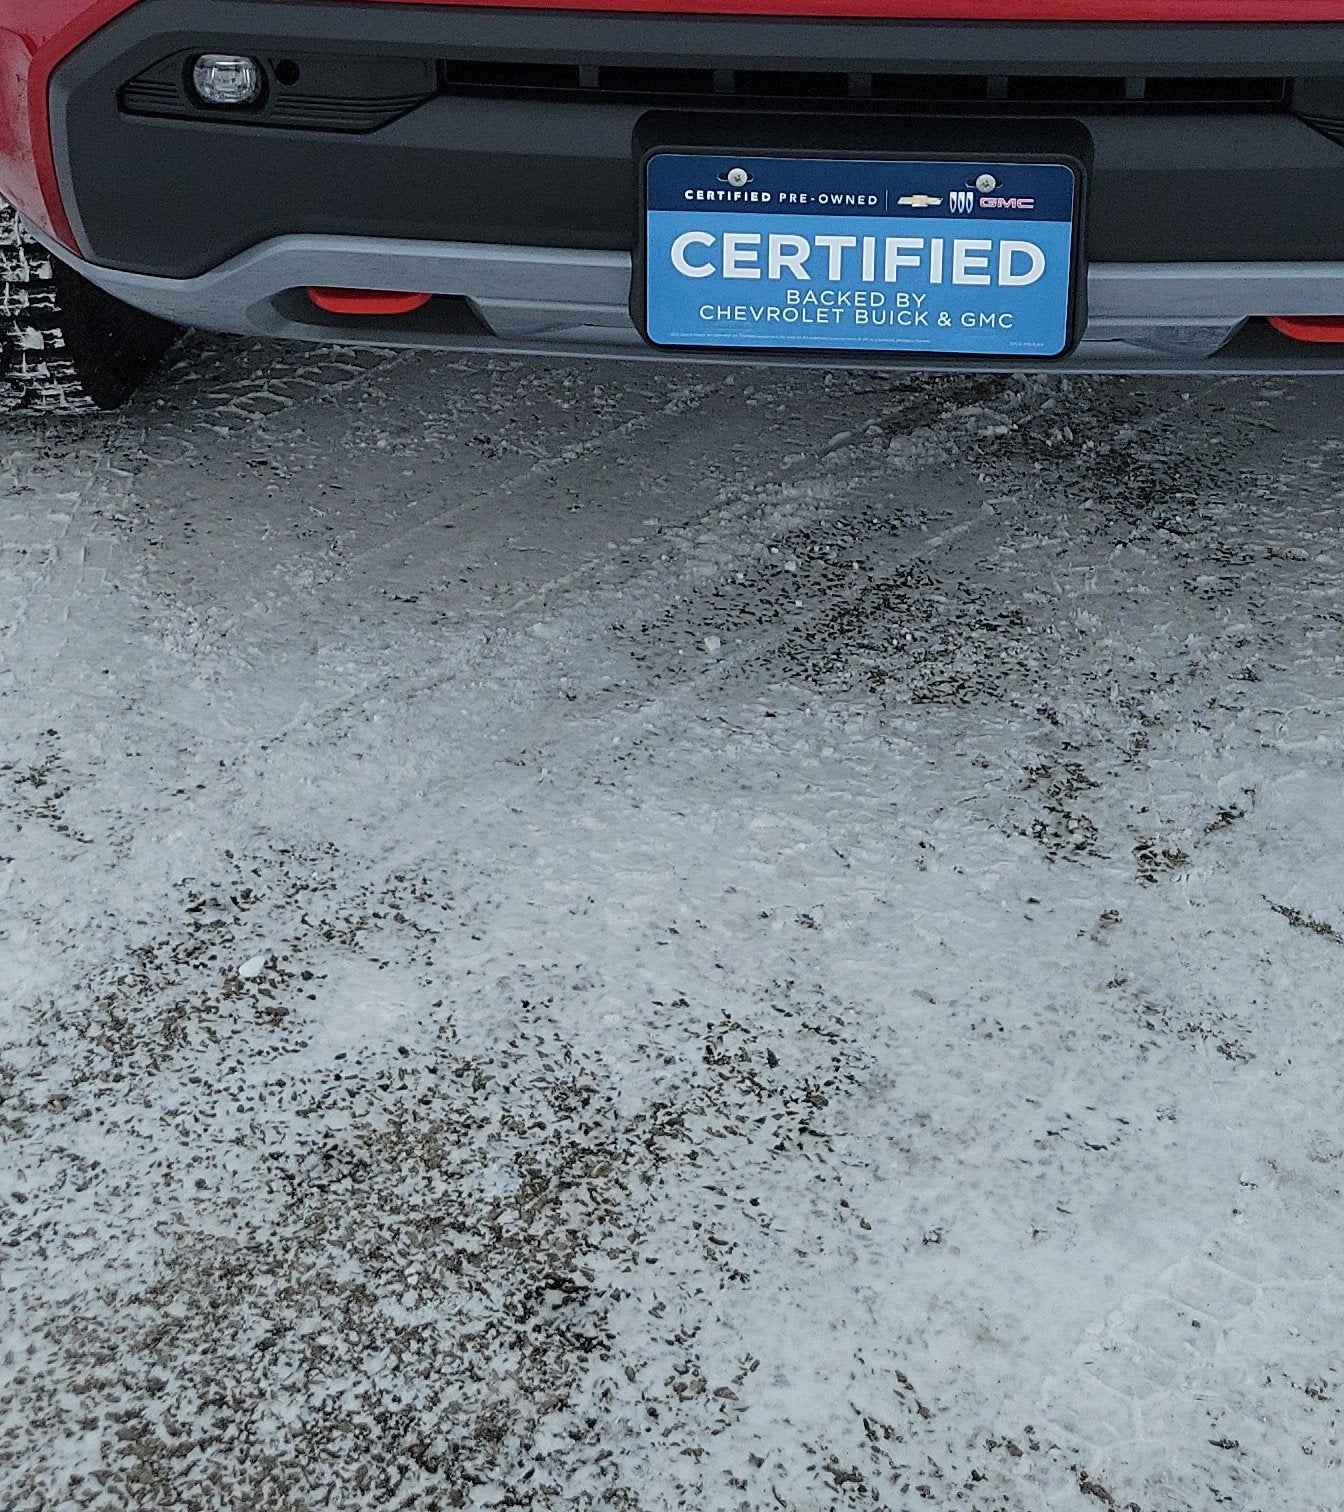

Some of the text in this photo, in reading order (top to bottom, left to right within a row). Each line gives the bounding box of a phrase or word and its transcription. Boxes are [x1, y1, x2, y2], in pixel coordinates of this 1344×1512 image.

[684, 189, 1034, 209] CERTIFIED PRE-OWNED GMC
[669, 230, 1047, 286] CERTIFIED
[786, 289, 927, 308] BACKED BY
[699, 305, 1014, 328] CHEVROLET BUICK & GMC
